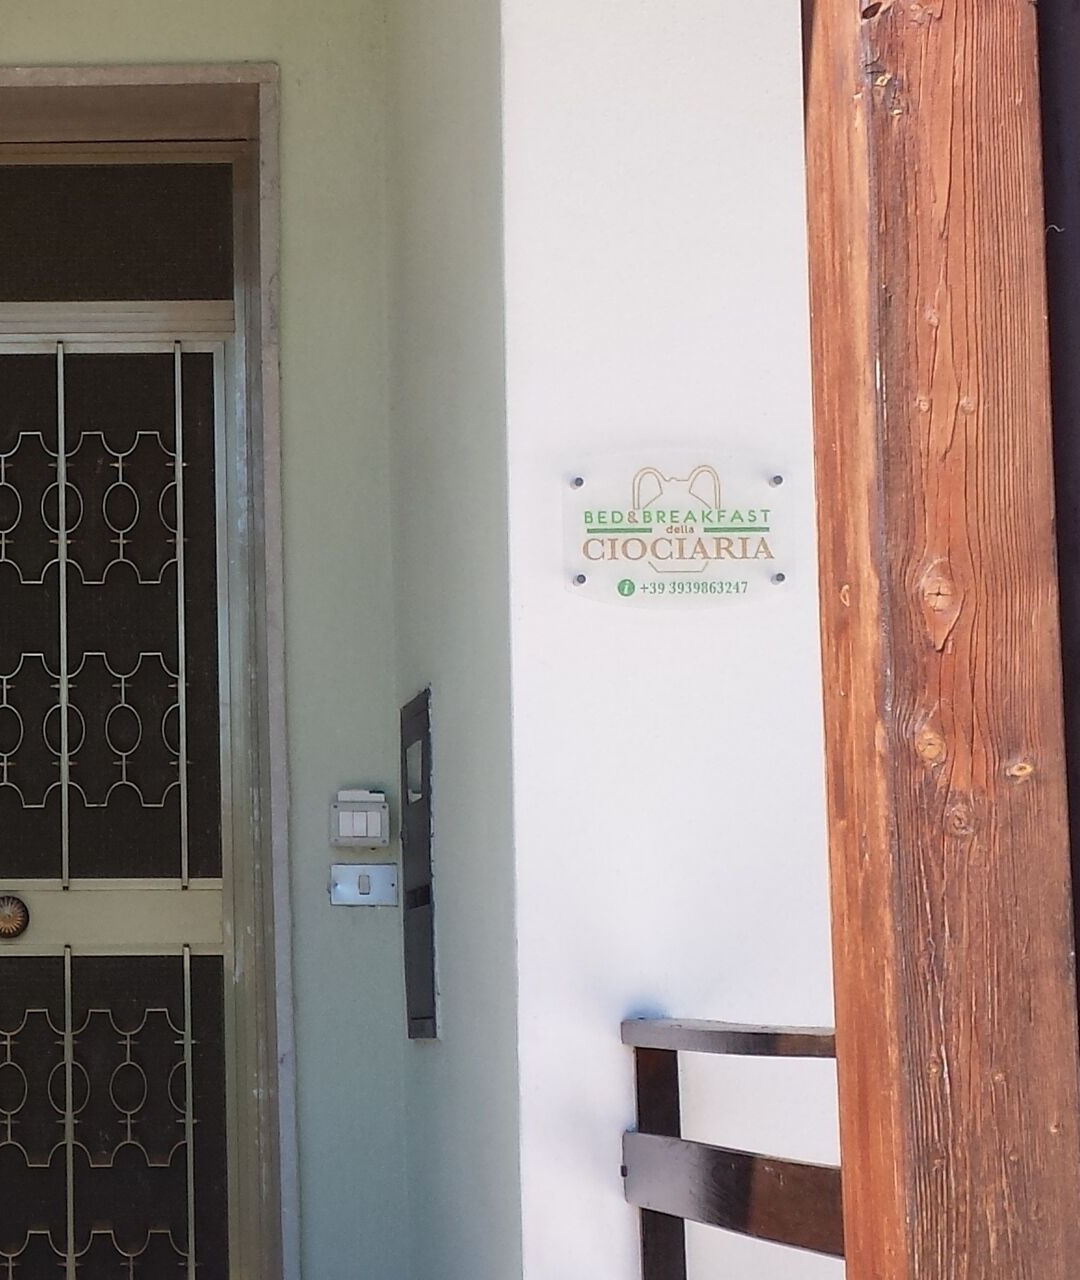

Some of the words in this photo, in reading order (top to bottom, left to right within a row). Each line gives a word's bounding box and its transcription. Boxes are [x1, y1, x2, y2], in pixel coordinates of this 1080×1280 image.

[665, 525, 695, 534] della
[582, 536, 775, 561] CIOCIARIA
[640, 582, 665, 594] +39
[669, 581, 748, 594] 3939863247
